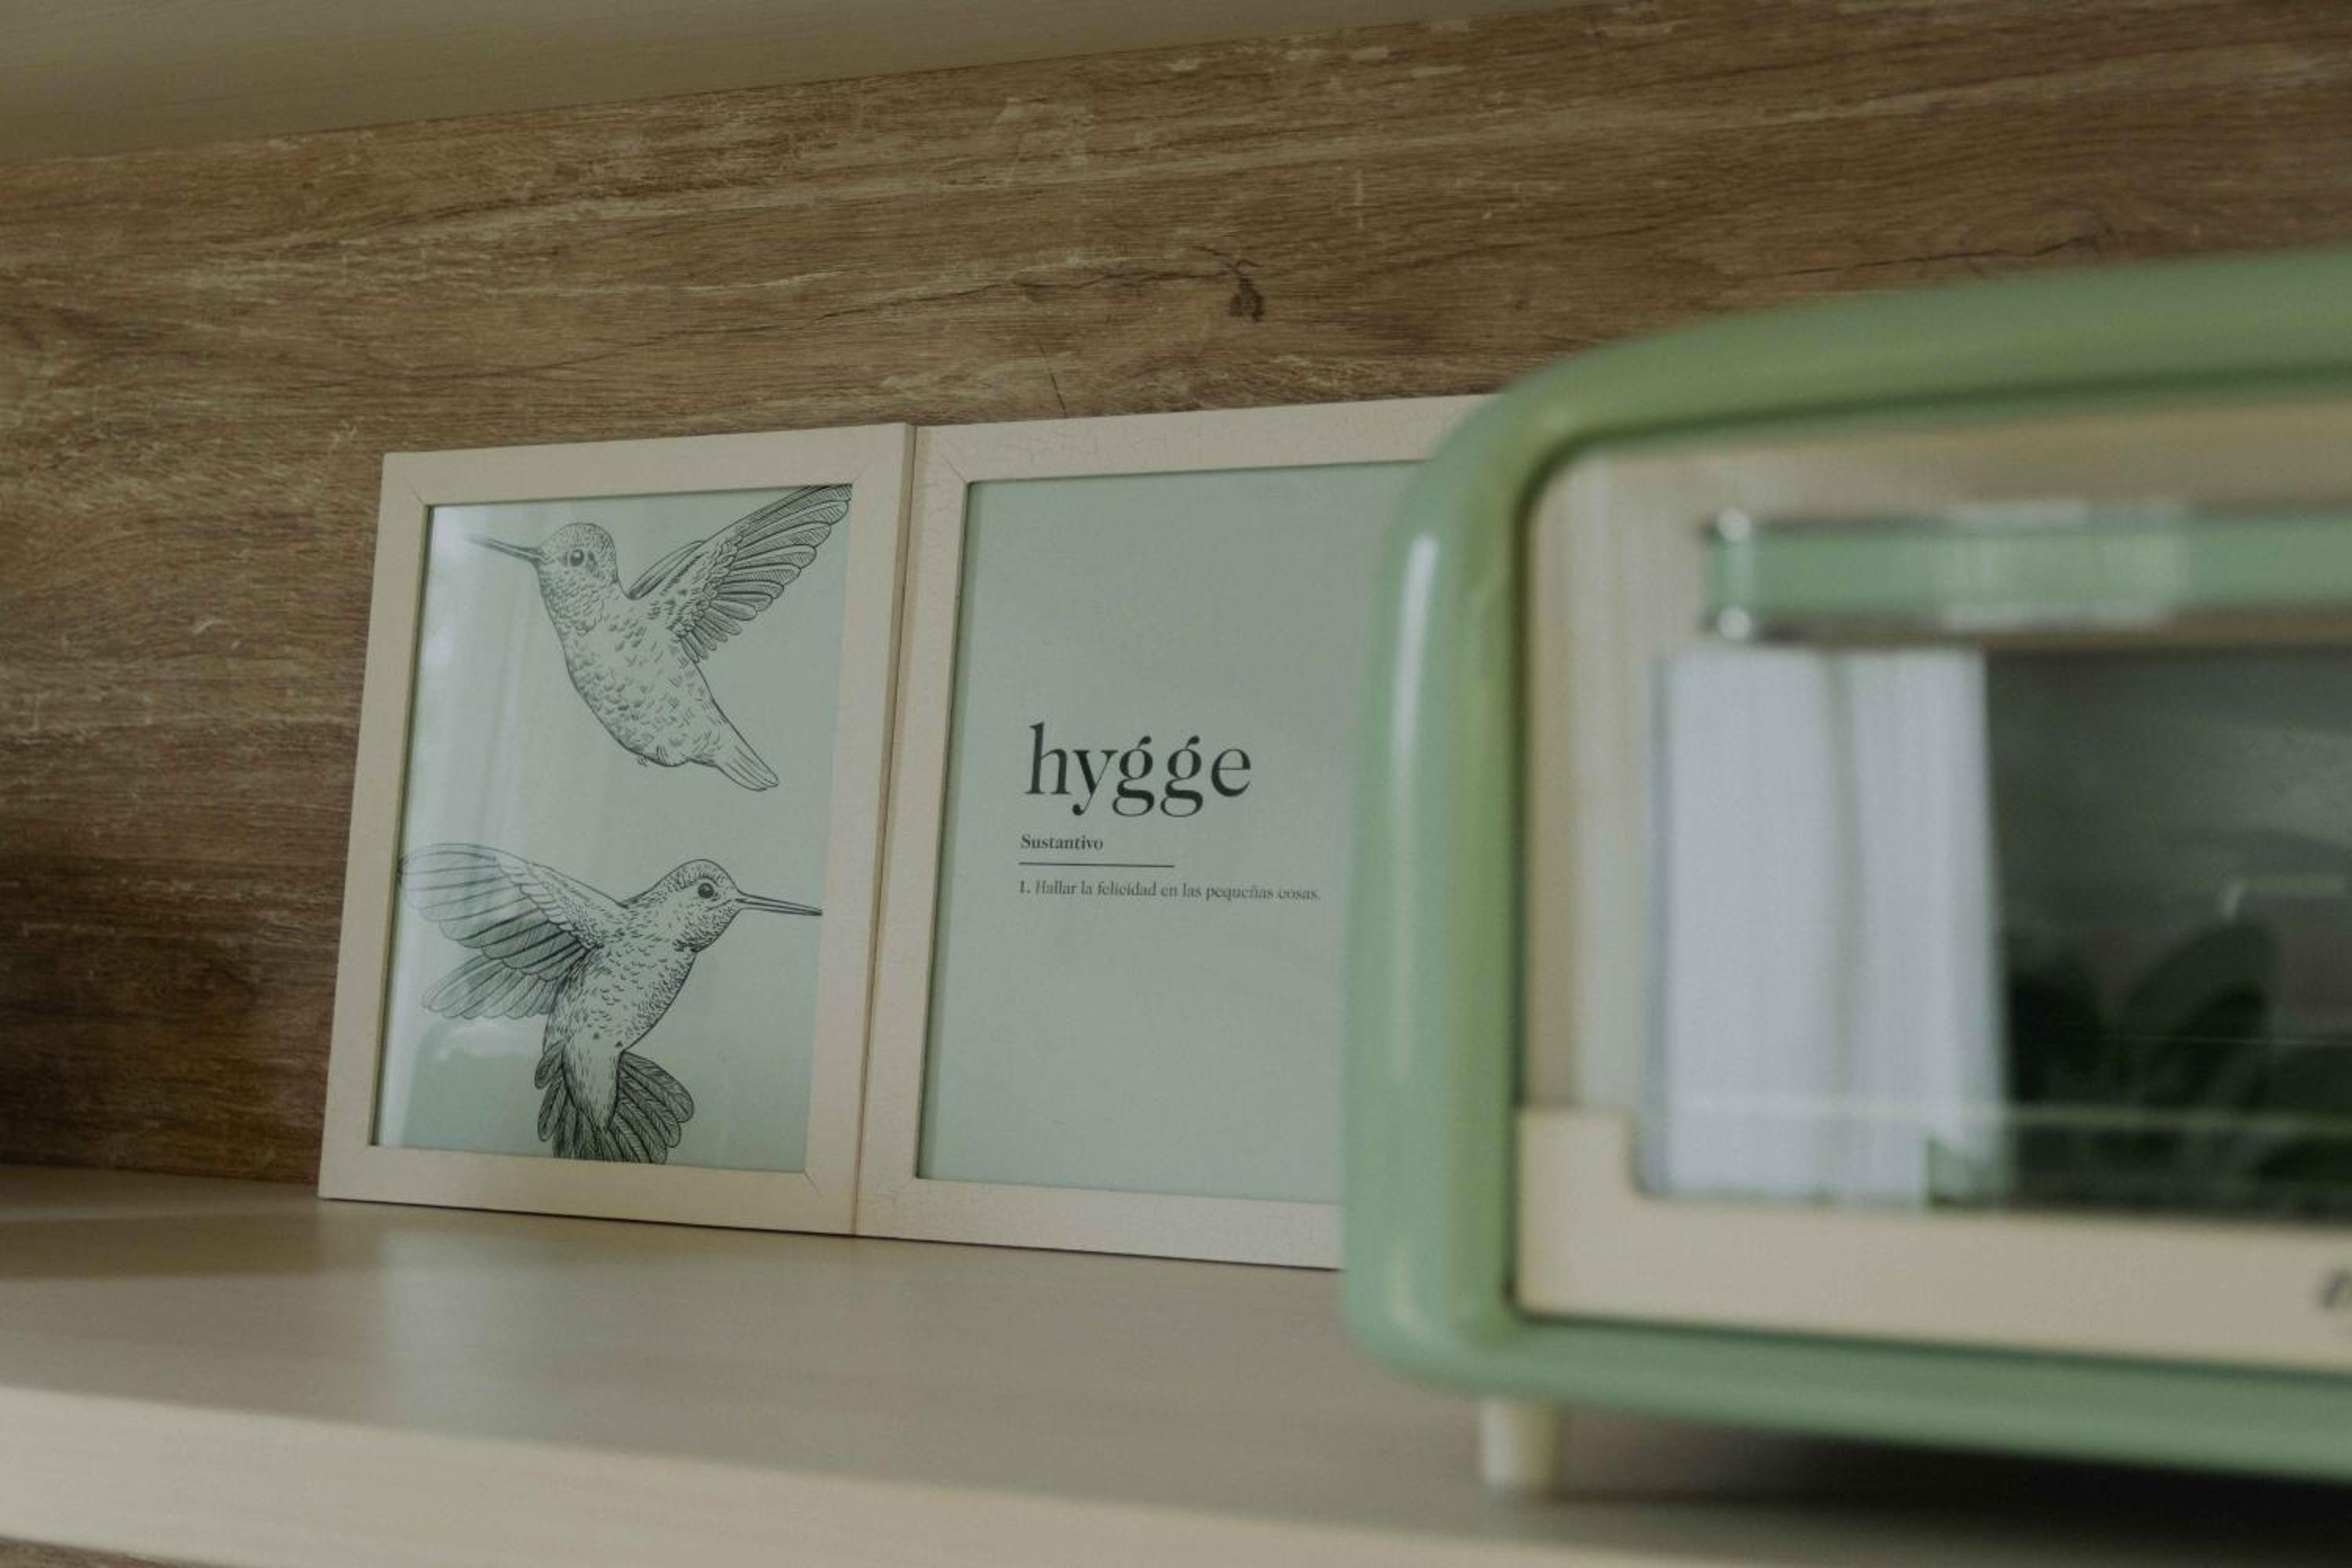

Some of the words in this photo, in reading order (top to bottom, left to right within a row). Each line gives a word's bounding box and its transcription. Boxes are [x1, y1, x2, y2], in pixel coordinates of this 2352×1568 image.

[1024, 721, 1251, 818] hygge
[1020, 833, 1104, 851] Sustantivo
[1019, 880, 1031, 895] 1.
[1035, 879, 1078, 895] Hallar
[1080, 880, 1093, 895] la
[1098, 880, 1157, 897] felicidad
[1160, 886, 1178, 898] en
[1182, 882, 1202, 898] las
[1206, 884, 1274, 902] pequeñas
[1277, 889, 1320, 901] cosas.
